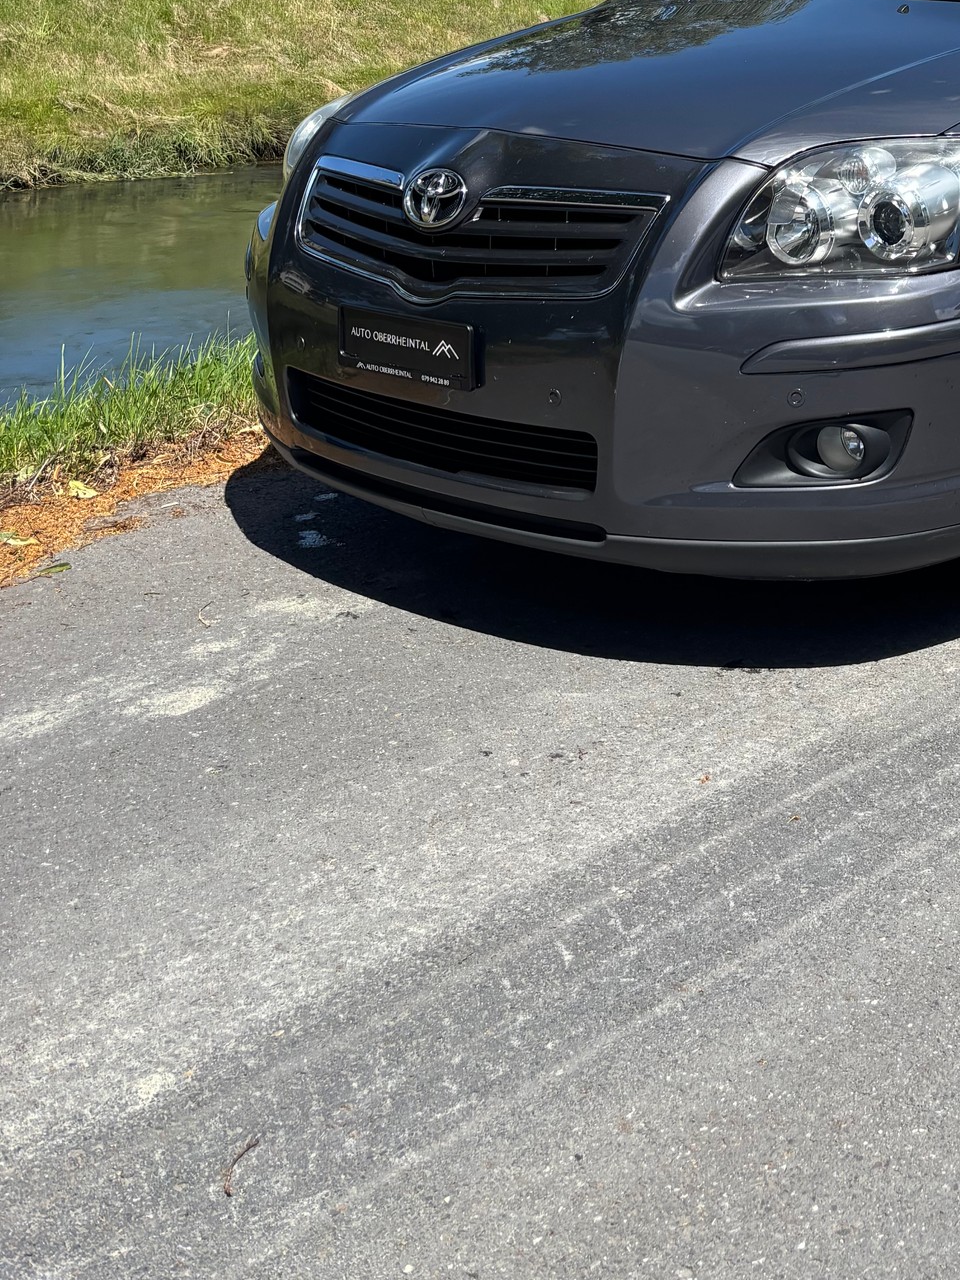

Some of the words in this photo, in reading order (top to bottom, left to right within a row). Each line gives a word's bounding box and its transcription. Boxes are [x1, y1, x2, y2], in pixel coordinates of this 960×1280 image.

[350, 326, 371, 339] AUTO
[372, 331, 430, 351] OBERRHEINTAL
[366, 363, 379, 372] AUTO
[379, 366, 412, 379] OBERRHEINTAL
